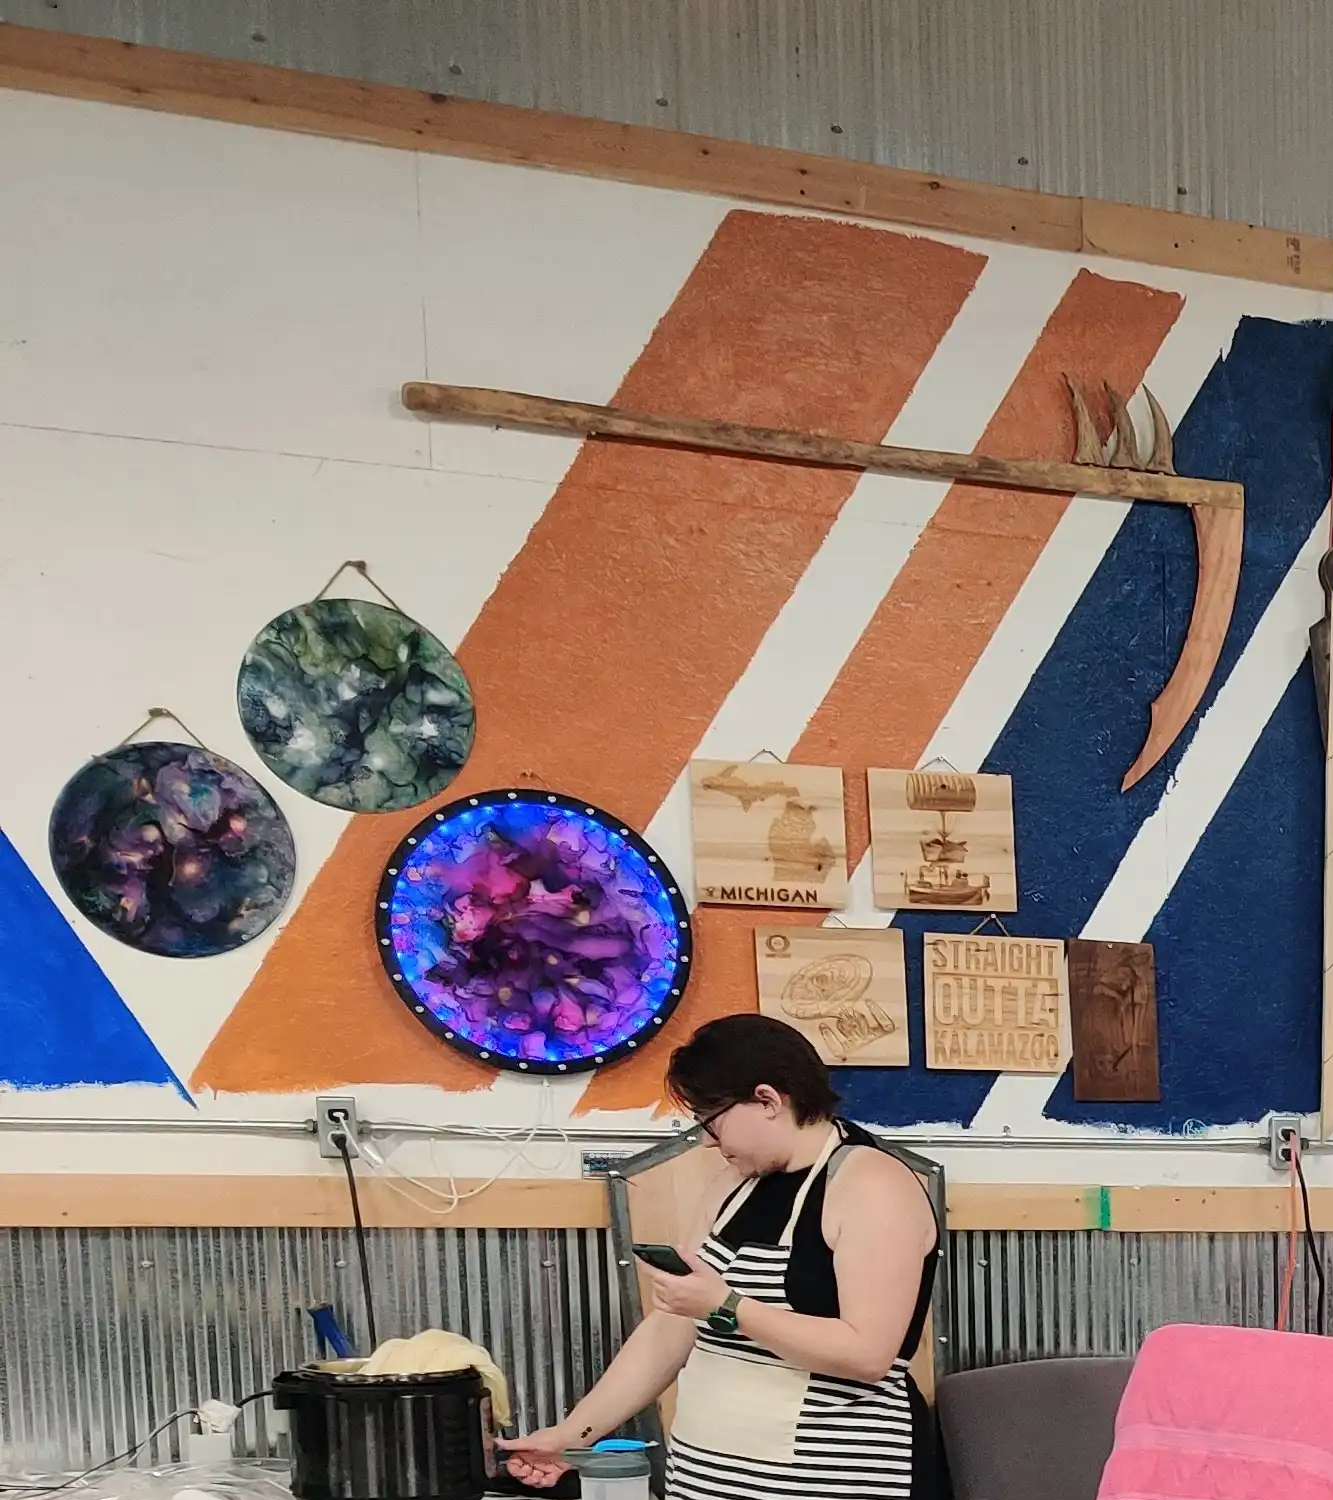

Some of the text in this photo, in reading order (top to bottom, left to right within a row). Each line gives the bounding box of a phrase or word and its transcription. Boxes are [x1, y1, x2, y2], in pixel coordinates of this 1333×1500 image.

[720, 886, 819, 904] MICHIGAN
[932, 939, 1059, 976] STRAIGHT
[934, 977, 1059, 1028] OUTTA
[934, 1030, 1059, 1067] KALAMAZOO
